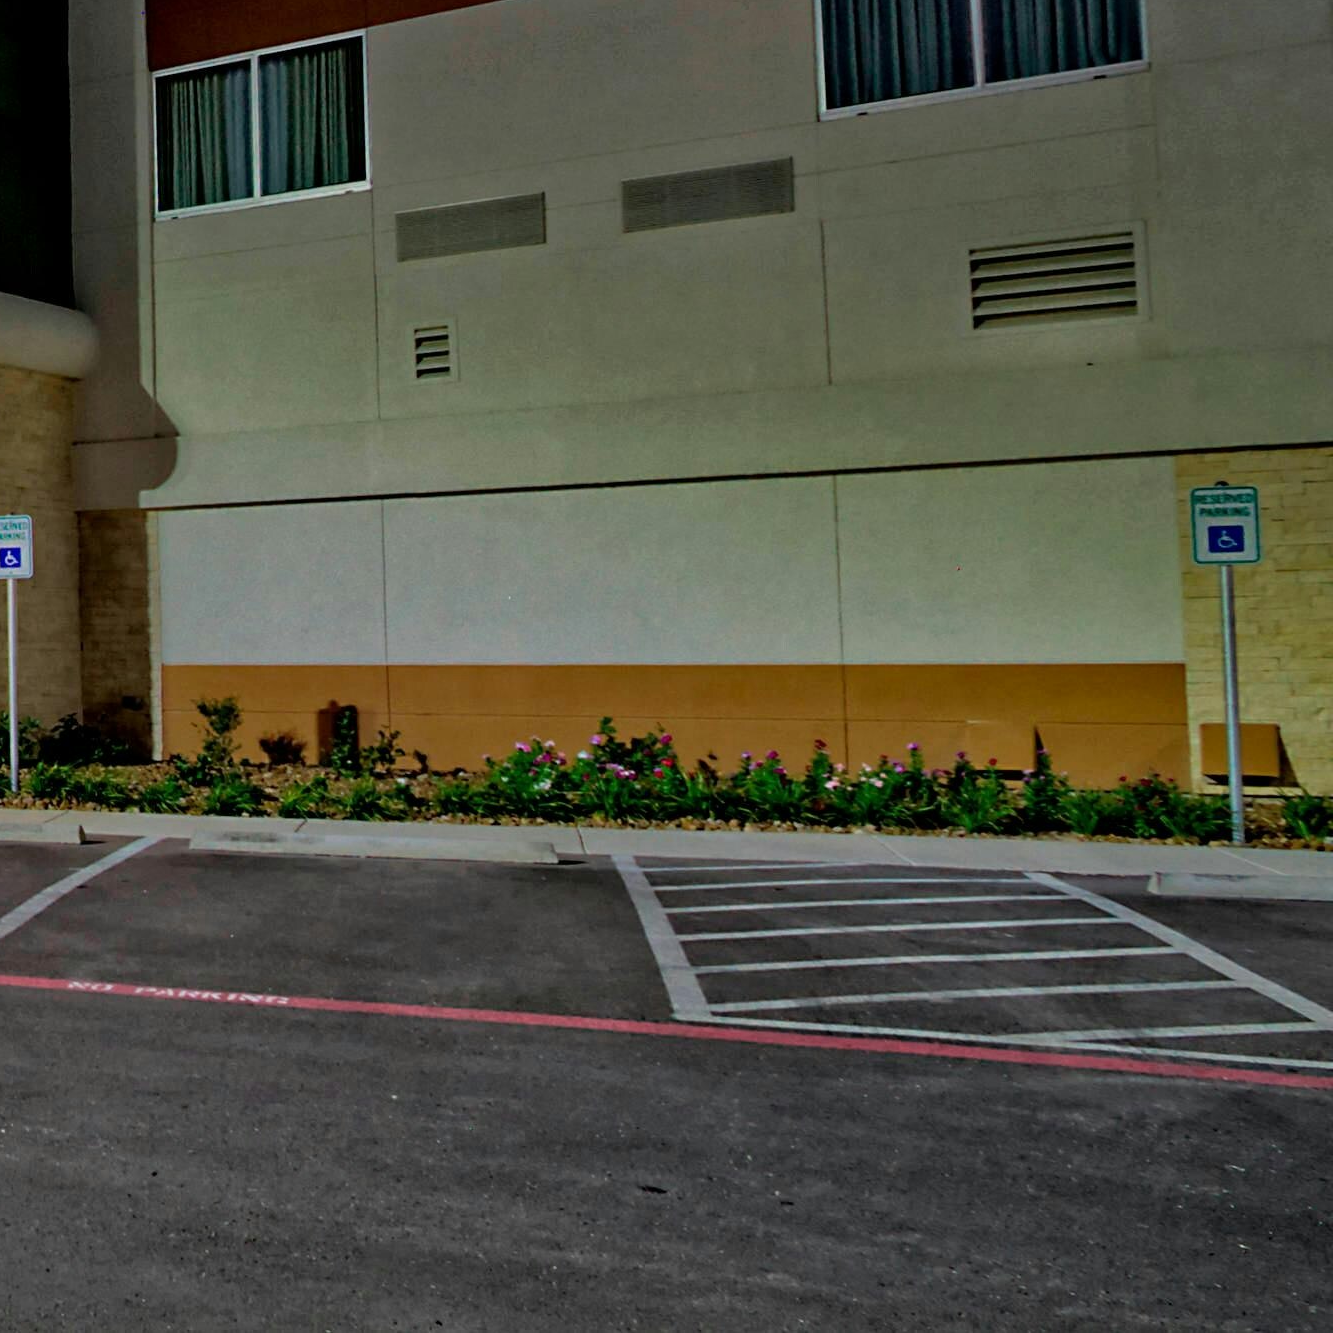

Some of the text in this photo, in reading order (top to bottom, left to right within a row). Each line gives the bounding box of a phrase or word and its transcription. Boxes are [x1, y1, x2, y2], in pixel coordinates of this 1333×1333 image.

[1194, 494, 1254, 505] RESERVED
[1199, 507, 1251, 517] PARKING
[67, 980, 115, 992] NO
[134, 986, 290, 1005] PARKING
